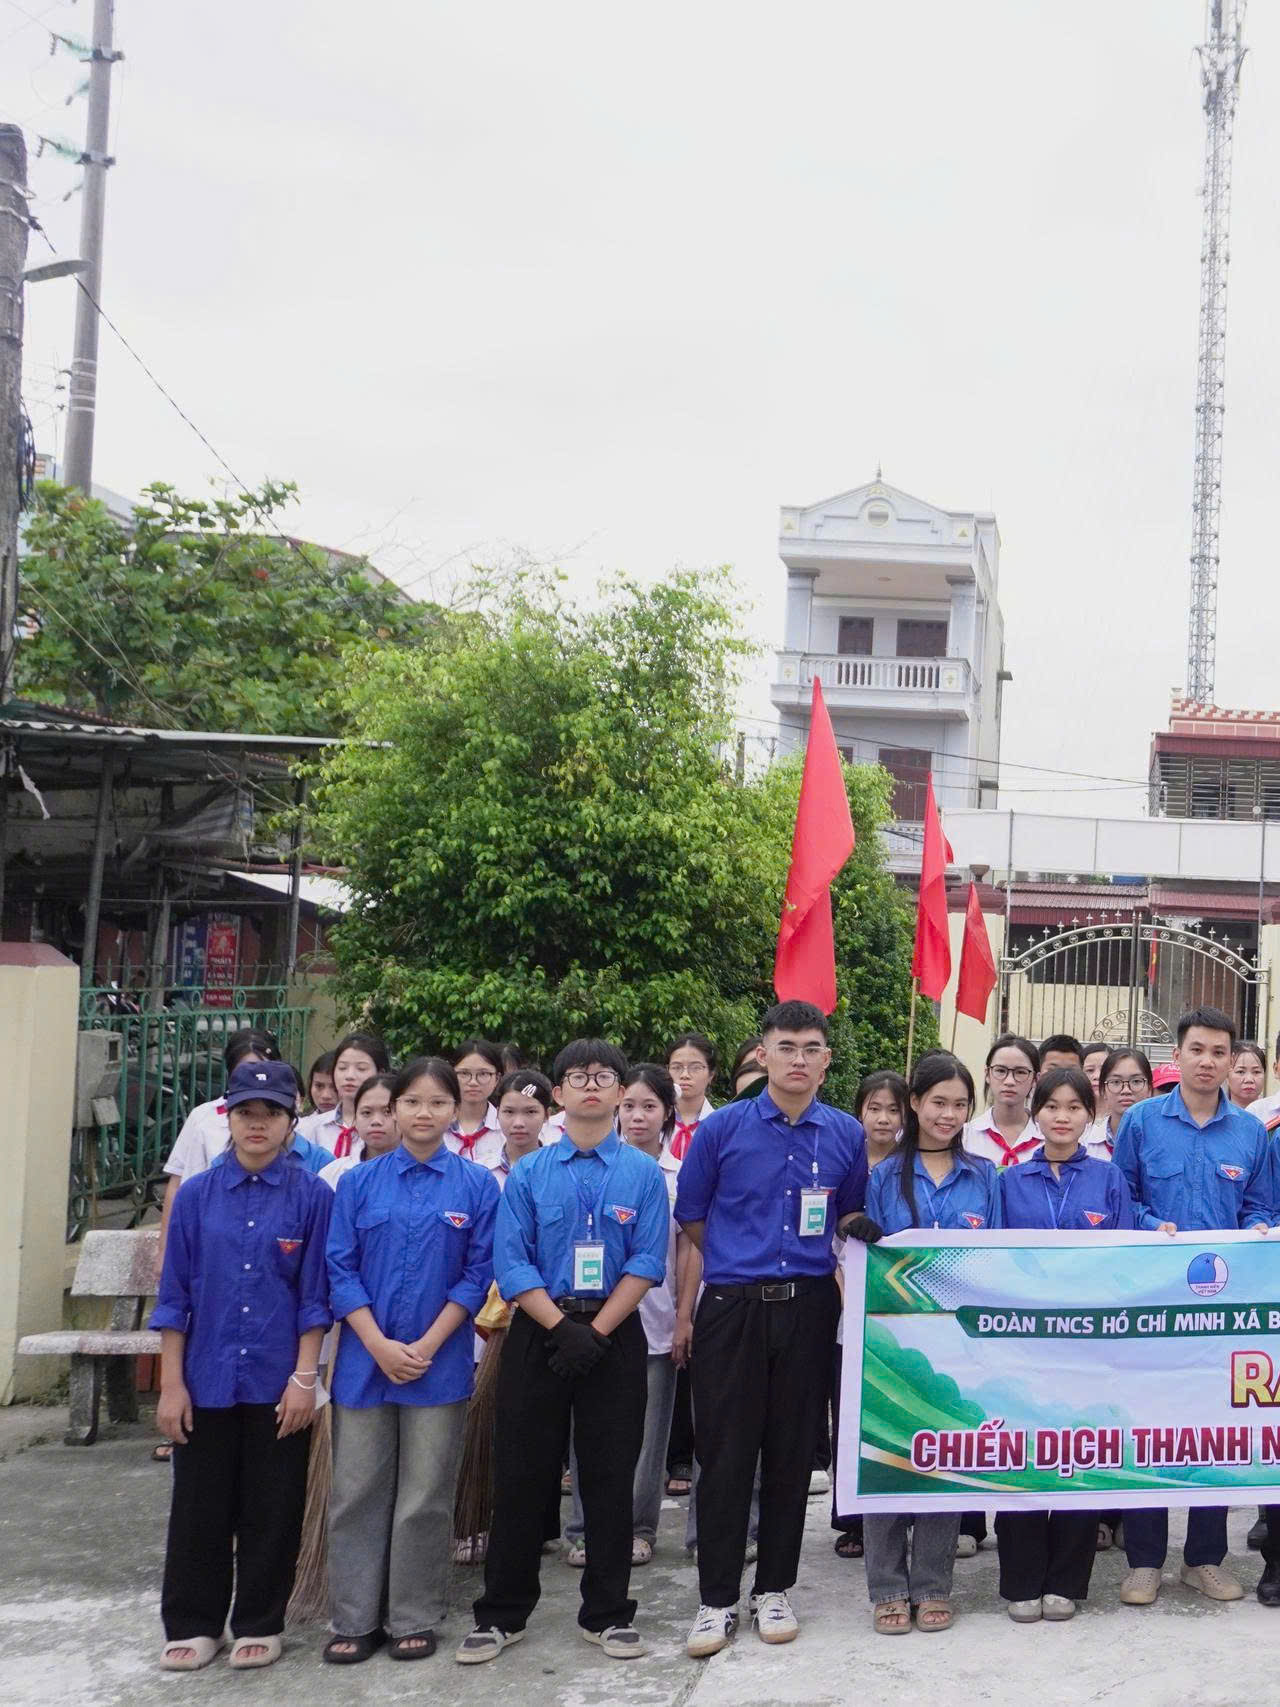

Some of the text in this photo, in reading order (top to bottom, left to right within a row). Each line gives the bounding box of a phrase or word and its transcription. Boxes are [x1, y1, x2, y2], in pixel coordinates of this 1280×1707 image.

[978, 1312, 1036, 1333] ĐOÀN
[1044, 1316, 1094, 1334] TNCS
[1102, 1310, 1129, 1334] HỒ
[1136, 1310, 1167, 1332] CHÍ
[1174, 1311, 1225, 1331] MINH
[1233, 1308, 1261, 1329] XÃ
[912, 1418, 1026, 1470] CHIẾN
[1035, 1427, 1122, 1476] DỊCH
[1132, 1425, 1251, 1466] THANH
